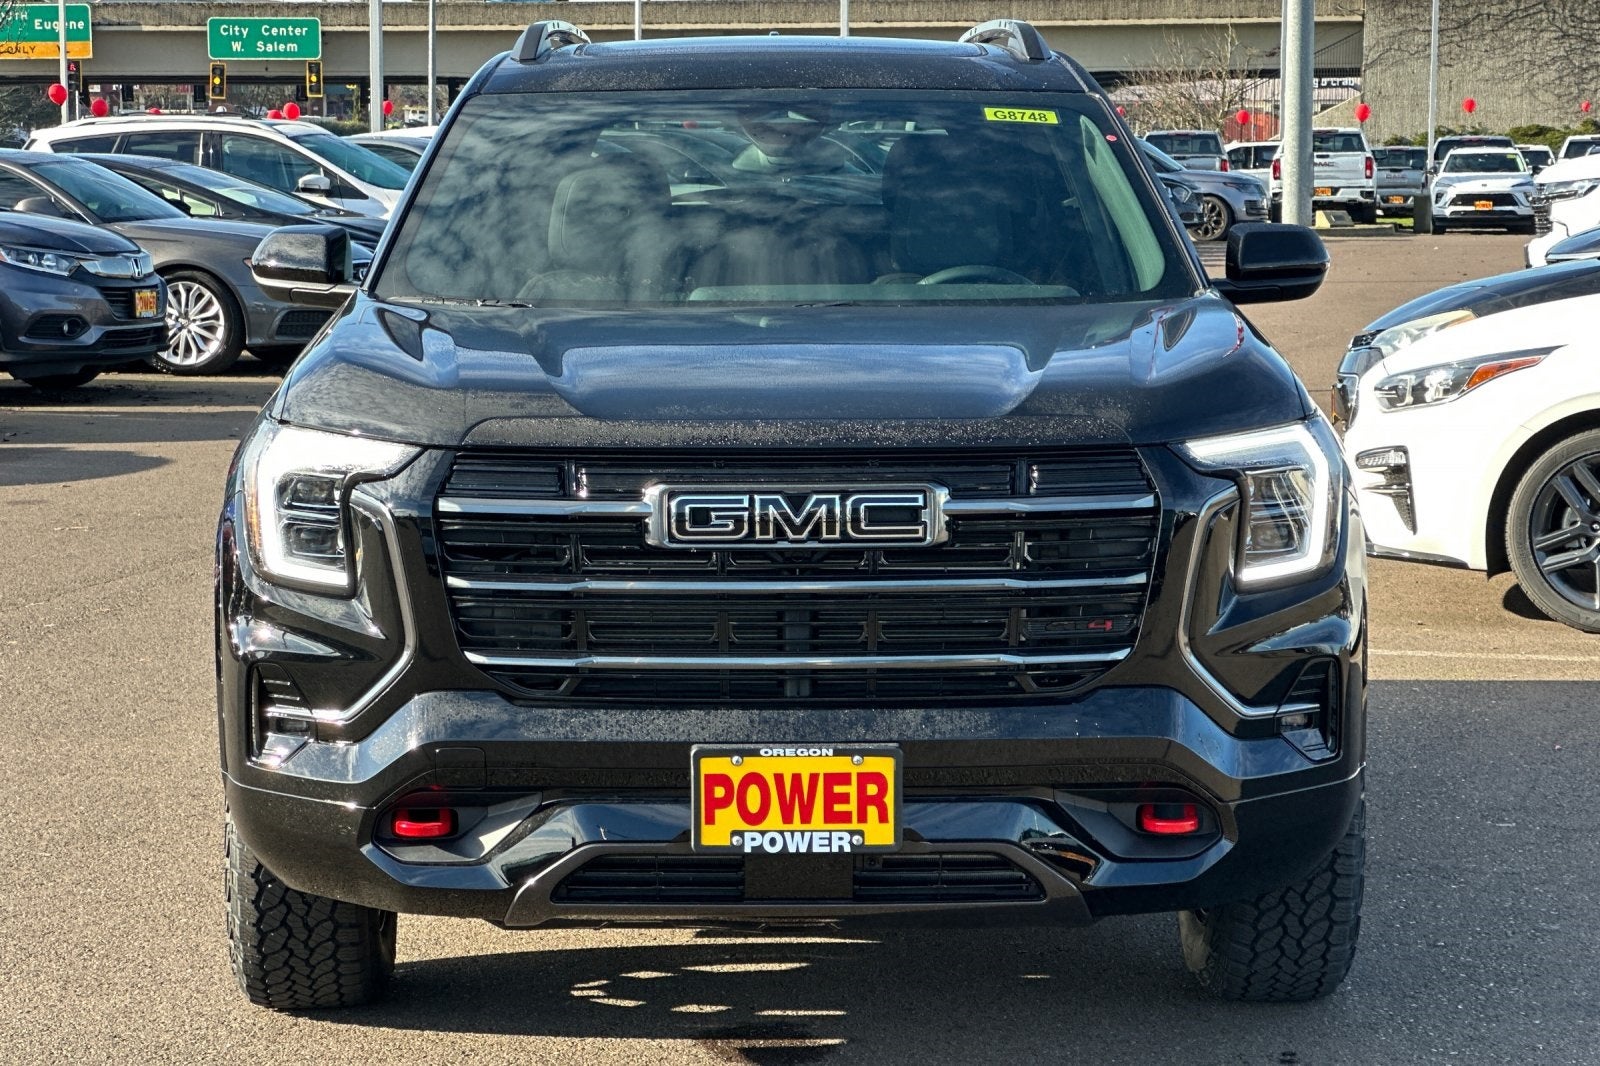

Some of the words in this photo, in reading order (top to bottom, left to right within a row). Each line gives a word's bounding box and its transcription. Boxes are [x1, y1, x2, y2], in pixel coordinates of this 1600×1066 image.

[34, 19, 85, 33] Eugne
[220, 25, 249, 38] City
[261, 25, 308, 36] Center
[231, 41, 245, 52] W.
[256, 41, 298, 52] Salem
[993, 110, 1048, 122] G8748
[670, 494, 925, 540] GMC
[759, 748, 834, 757] OREGON
[703, 771, 890, 827] POWER
[743, 831, 852, 853] POWER
